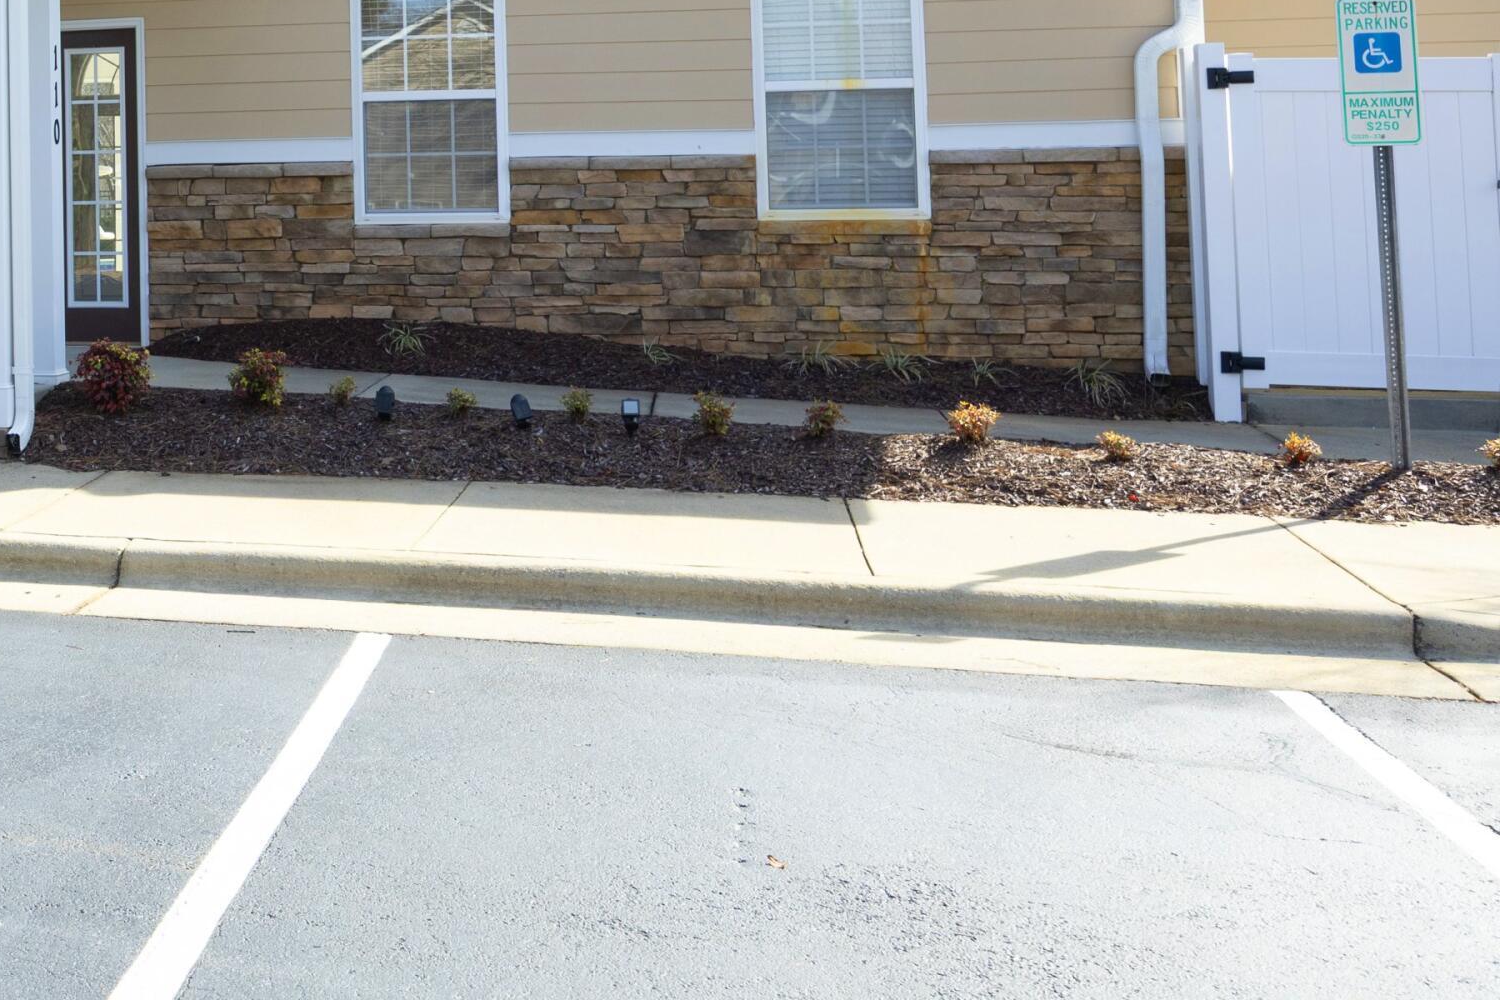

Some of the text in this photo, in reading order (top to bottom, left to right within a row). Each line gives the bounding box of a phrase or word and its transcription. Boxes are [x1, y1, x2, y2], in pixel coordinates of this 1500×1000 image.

[1343, 0, 1407, 15] RESERVED
[1345, 16, 1408, 31] PARKING
[1349, 97, 1414, 108] MAXIMUM
[1351, 108, 1412, 120] PENALTY
[1366, 121, 1399, 131] $250
